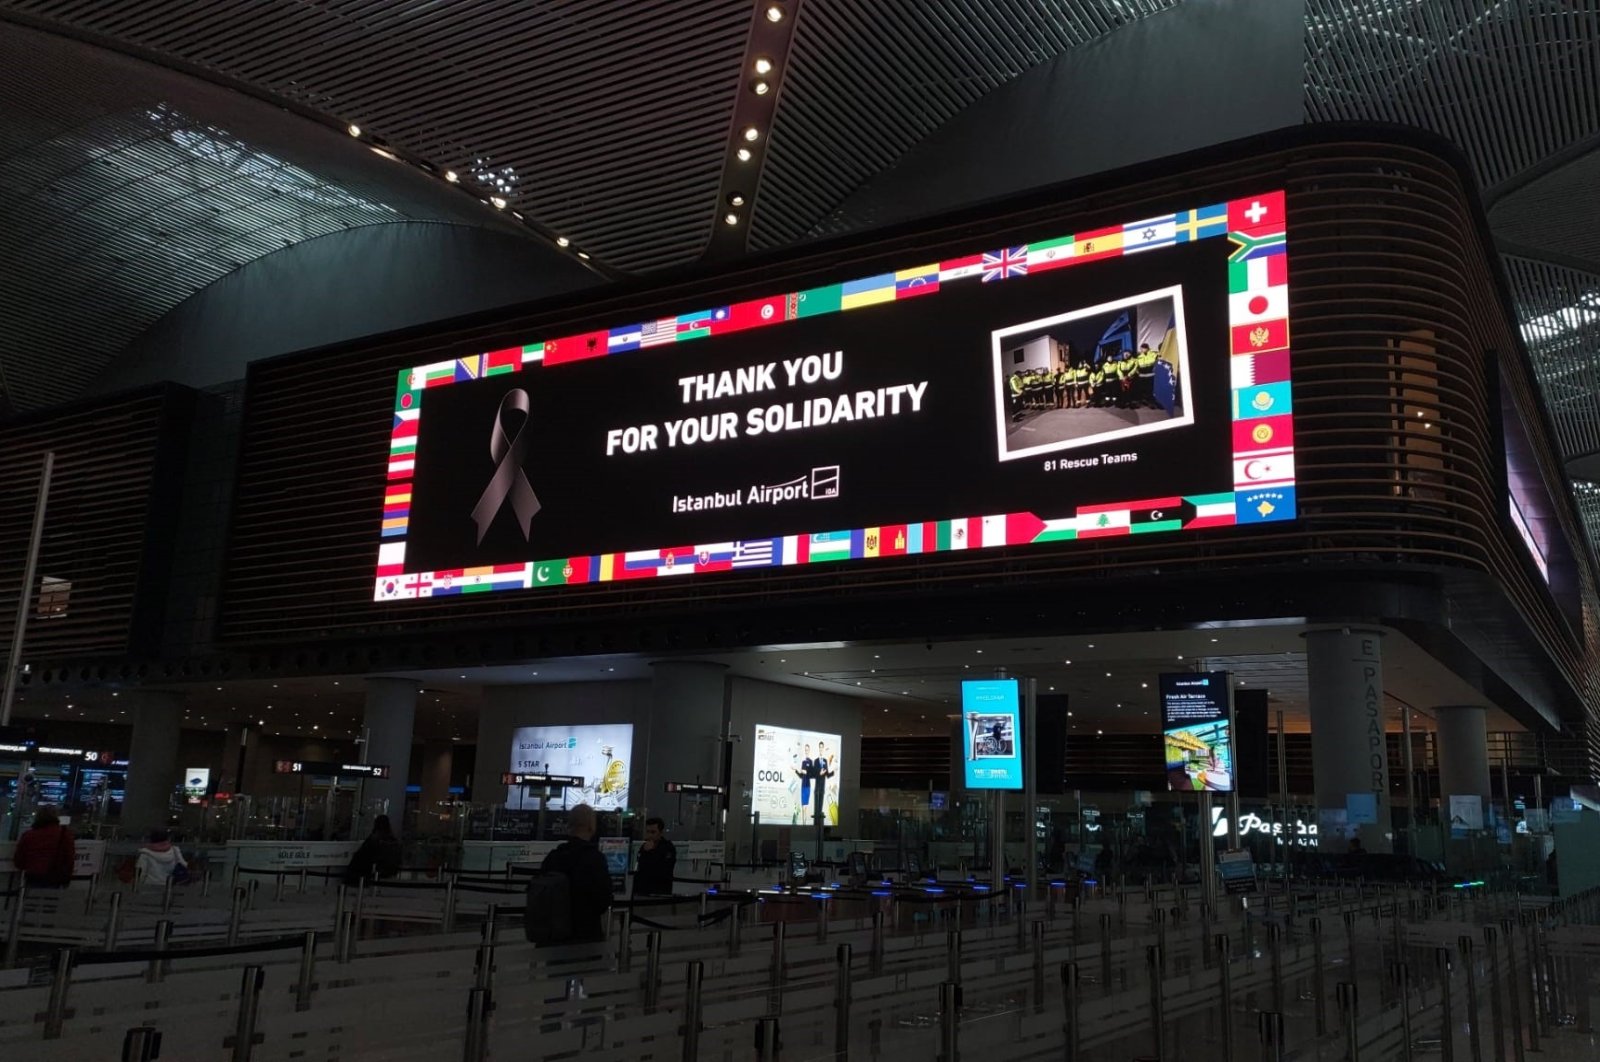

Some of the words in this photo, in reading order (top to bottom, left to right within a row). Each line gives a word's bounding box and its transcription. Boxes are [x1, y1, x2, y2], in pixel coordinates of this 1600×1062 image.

[678, 362, 777, 404] THANK
[783, 350, 843, 386] YOU
[606, 424, 658, 456] FOR
[664, 412, 738, 448] YOUR
[745, 381, 928, 436] SOLIDARITY
[1044, 460, 1057, 471] 81
[1060, 457, 1099, 470] Rescue
[1101, 453, 1138, 465] Teams
[672, 489, 742, 513] Istanbul
[747, 478, 808, 506] Airport
[519, 740, 544, 750] Istanbul
[545, 739, 567, 750] Airport
[84, 751, 98, 761] 50
[292, 762, 302, 772] 51
[524, 760, 540, 768] STAR
[372, 767, 382, 776] 52
[758, 769, 785, 783] COOL
